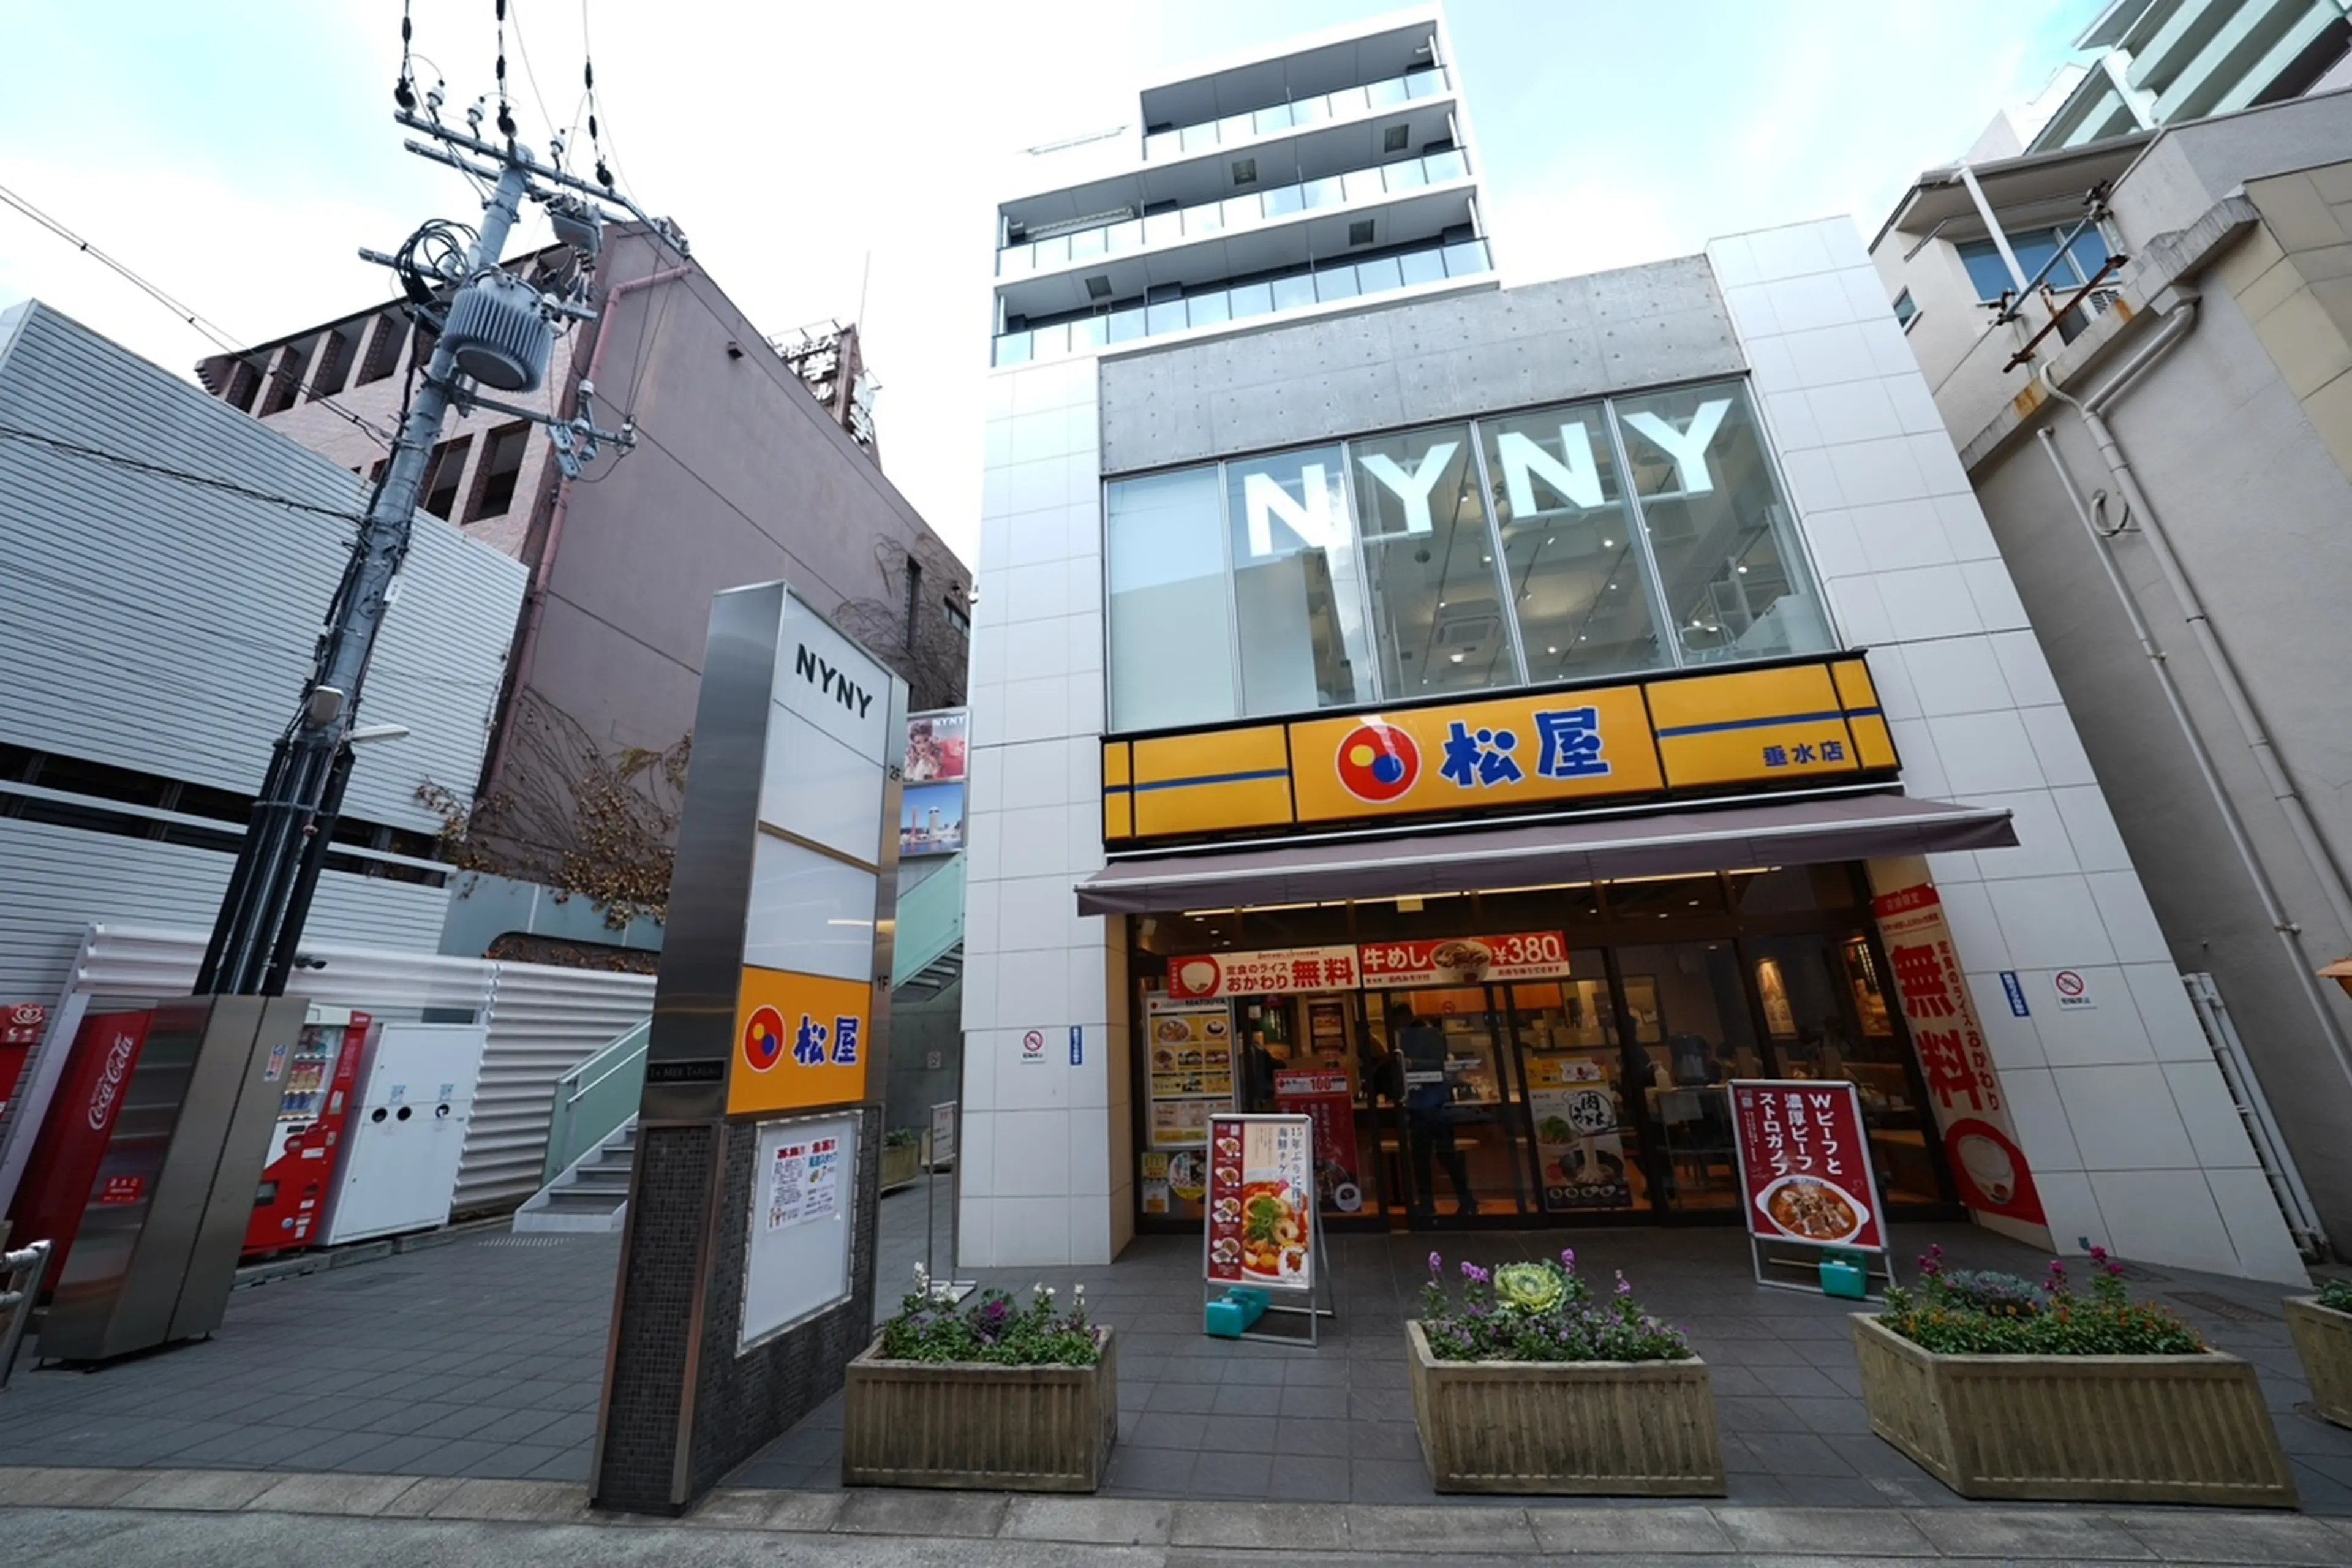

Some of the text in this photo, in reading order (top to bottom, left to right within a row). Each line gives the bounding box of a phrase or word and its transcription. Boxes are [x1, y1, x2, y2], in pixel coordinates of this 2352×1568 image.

[1243, 398, 1733, 557] NYNY
[796, 643, 873, 720] NYNY
[933, 715, 966, 726] NYNY
[1438, 706, 1611, 788] 松屋
[1763, 739, 1845, 767] 垂水店
[1363, 946, 1427, 971] 牛めし
[1493, 935, 1561, 965] ¥380
[878, 974, 889, 992] 1F
[1226, 962, 1288, 976] 定食のライス
[1226, 974, 1289, 992] おかわり
[1292, 956, 1354, 988] 無料
[792, 1012, 860, 1066] 松屋
[1891, 944, 1983, 1112] 無料
[1759, 1093, 1789, 1176] ストロガノフ
[1808, 1093, 1842, 1175] Wビーフと
